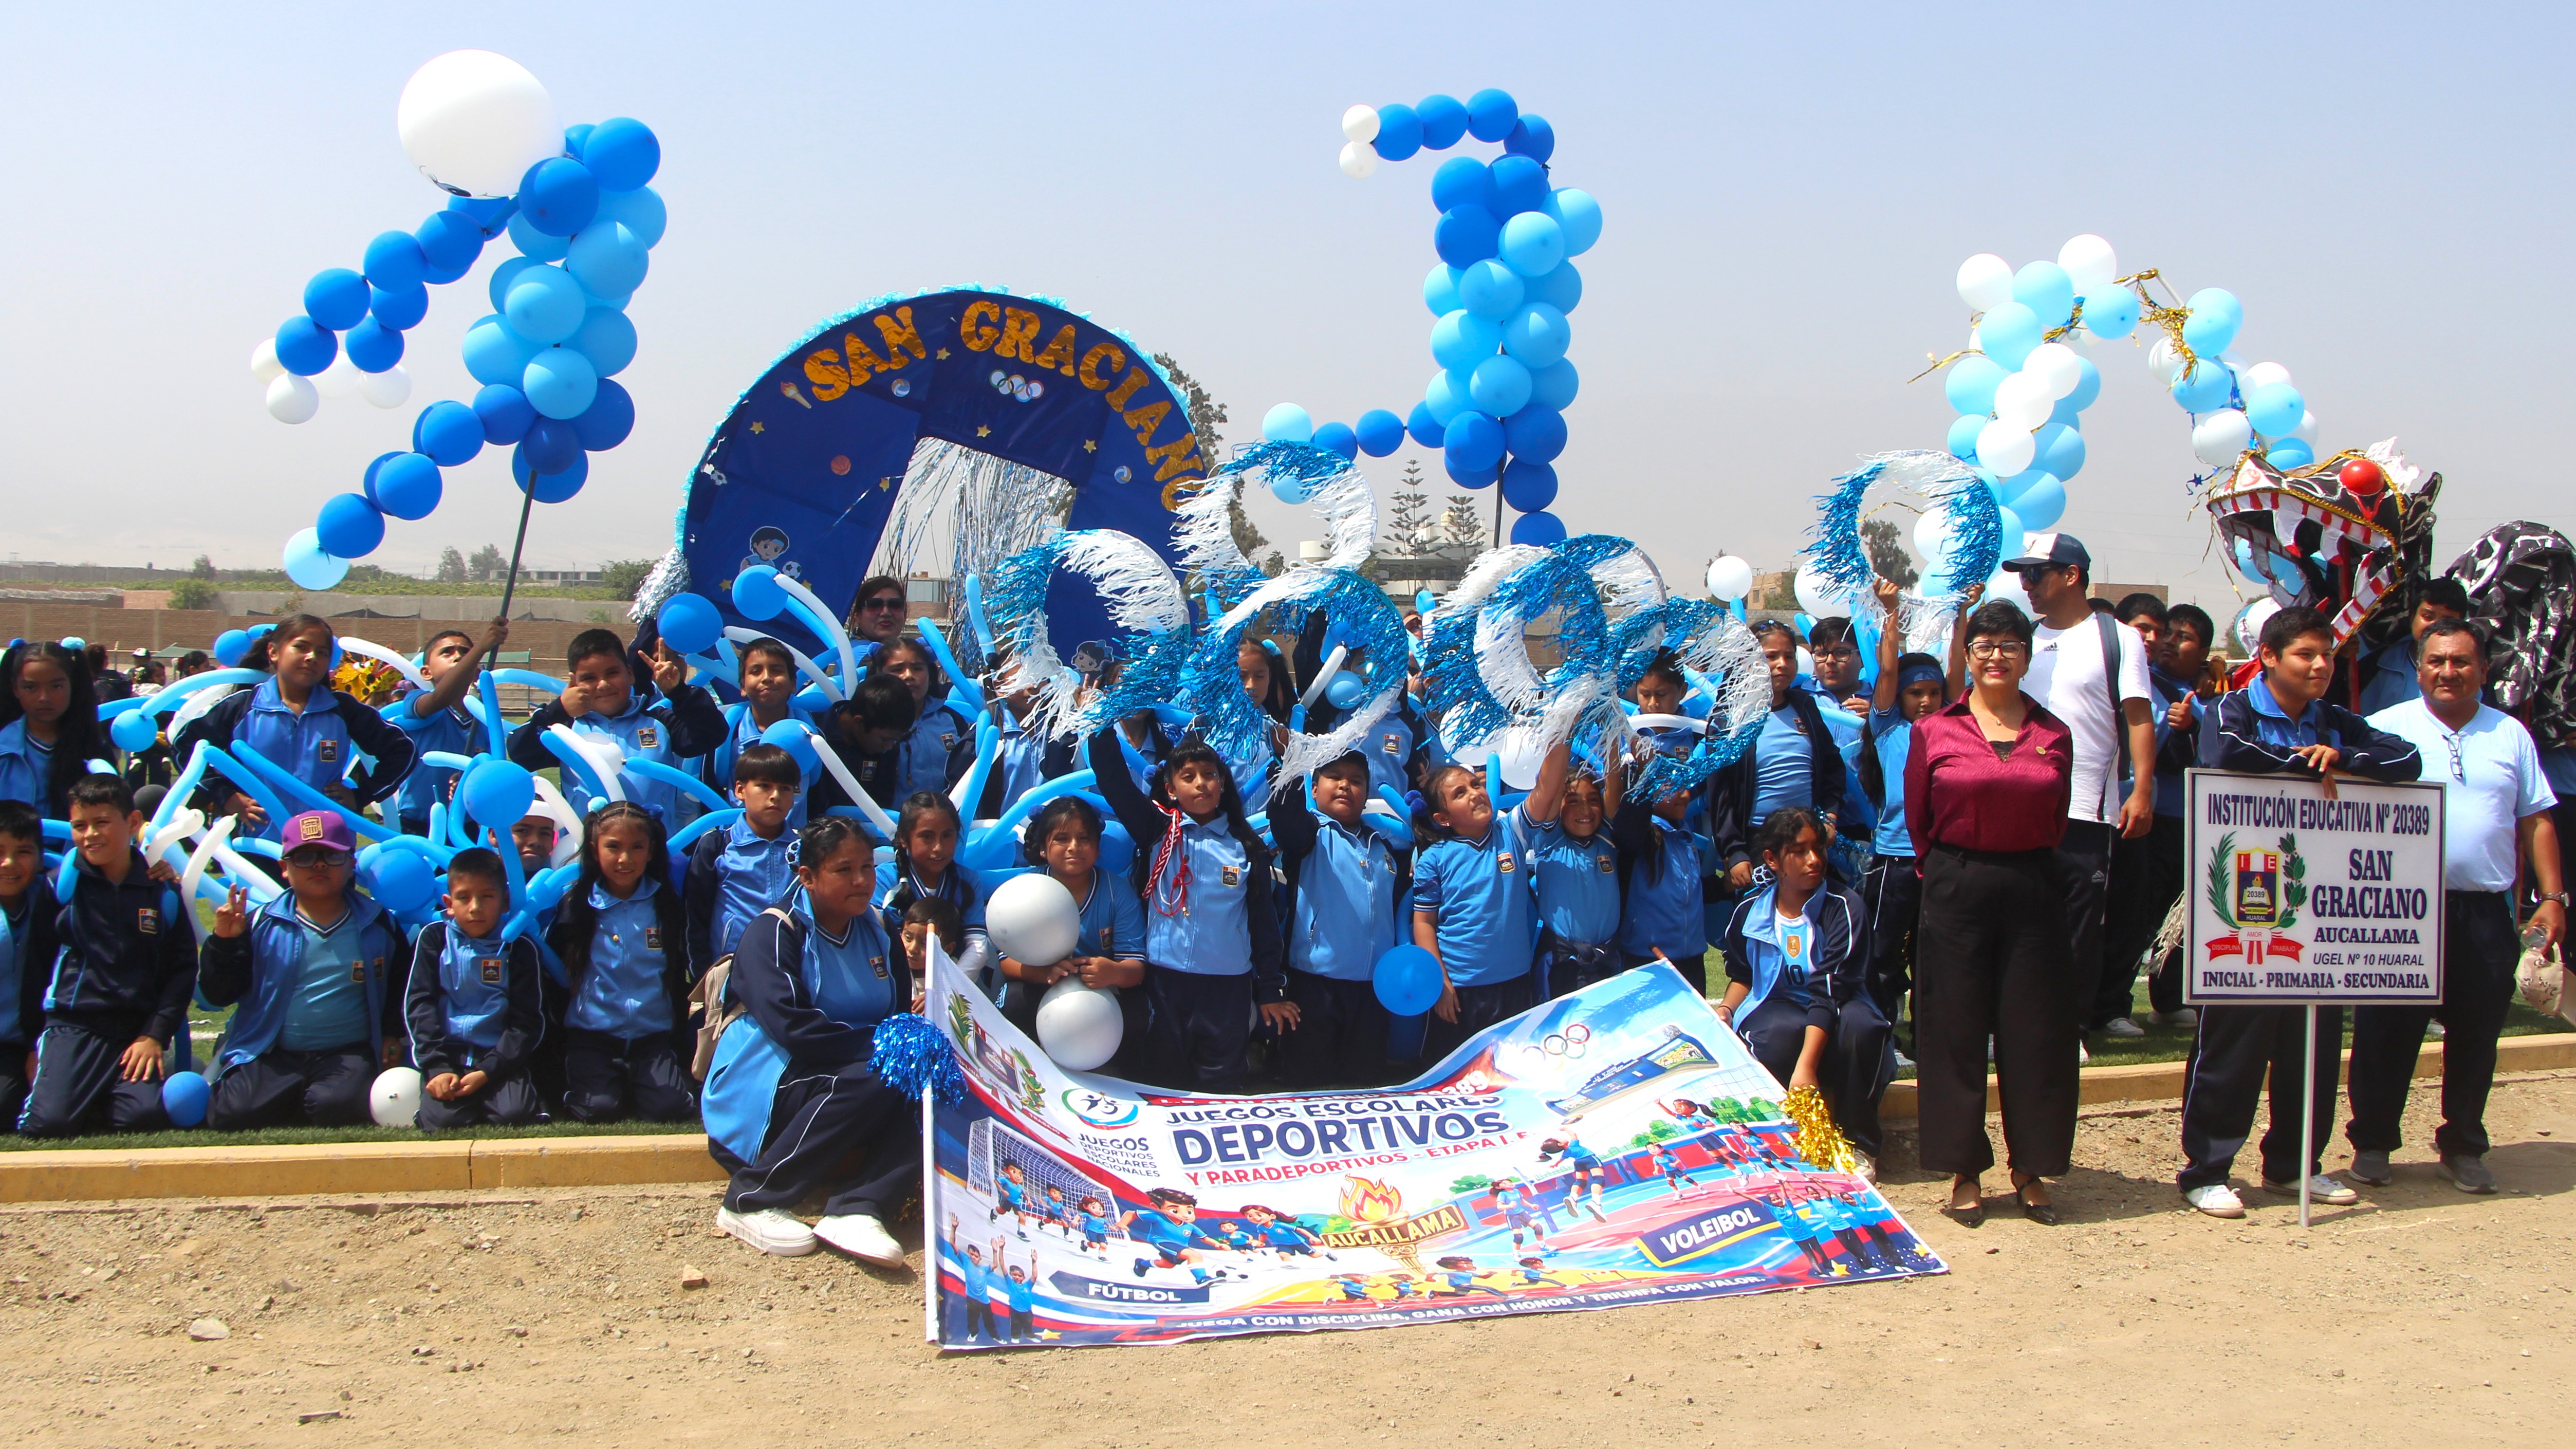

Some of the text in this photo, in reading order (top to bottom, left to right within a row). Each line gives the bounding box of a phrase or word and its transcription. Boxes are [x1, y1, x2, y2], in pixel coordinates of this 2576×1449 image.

[804, 301, 1206, 512] SAN GRACIANO
[2209, 790, 2295, 829] INSTITUCIÓN
[2300, 799, 2372, 832] EDUCATIVA
[2393, 804, 2430, 835] 20389
[2241, 855, 2275, 869] I E
[2349, 848, 2393, 881] SAN
[2312, 885, 2427, 920] GRACIANO
[2314, 927, 2420, 944] AUCALLAMA
[2313, 953, 2344, 965] UGEL
[2363, 954, 2375, 965] 10
[2378, 954, 2424, 965] HUARAL
[1784, 964, 1805, 986] 10
[2202, 971, 2256, 988] INICIAL
[2266, 972, 2334, 988] PRIMARIA
[2344, 973, 2430, 989] SECUNDARIA
[1028, 1112, 1061, 1135] TRABAJO
[1167, 1106, 1297, 1124] JUEGOS
[1078, 1133, 1149, 1151] JUEGOS
[1173, 1112, 1509, 1165] DEPORTIVOS
[1079, 1141, 1154, 1160] DEPORTIVOS
[1083, 1148, 1157, 1168] ESCOLARES
[1185, 1172, 1199, 1185] Y
[1206, 1153, 1409, 1184] PARADEPORTIVOS
[1426, 1138, 1496, 1157] ETAPA
[1086, 1155, 1160, 1177] NACIONALES
[1328, 1209, 1459, 1248] AUCALLAMA
[1659, 1208, 1761, 1254] VOLEIBOL
[1088, 1282, 1181, 1303] FÚTBOL
[1176, 1276, 1766, 1328] JUEGA CON DISCIPLINA, GANA CON HONOR Y TRIUNFA CON VALOR.
